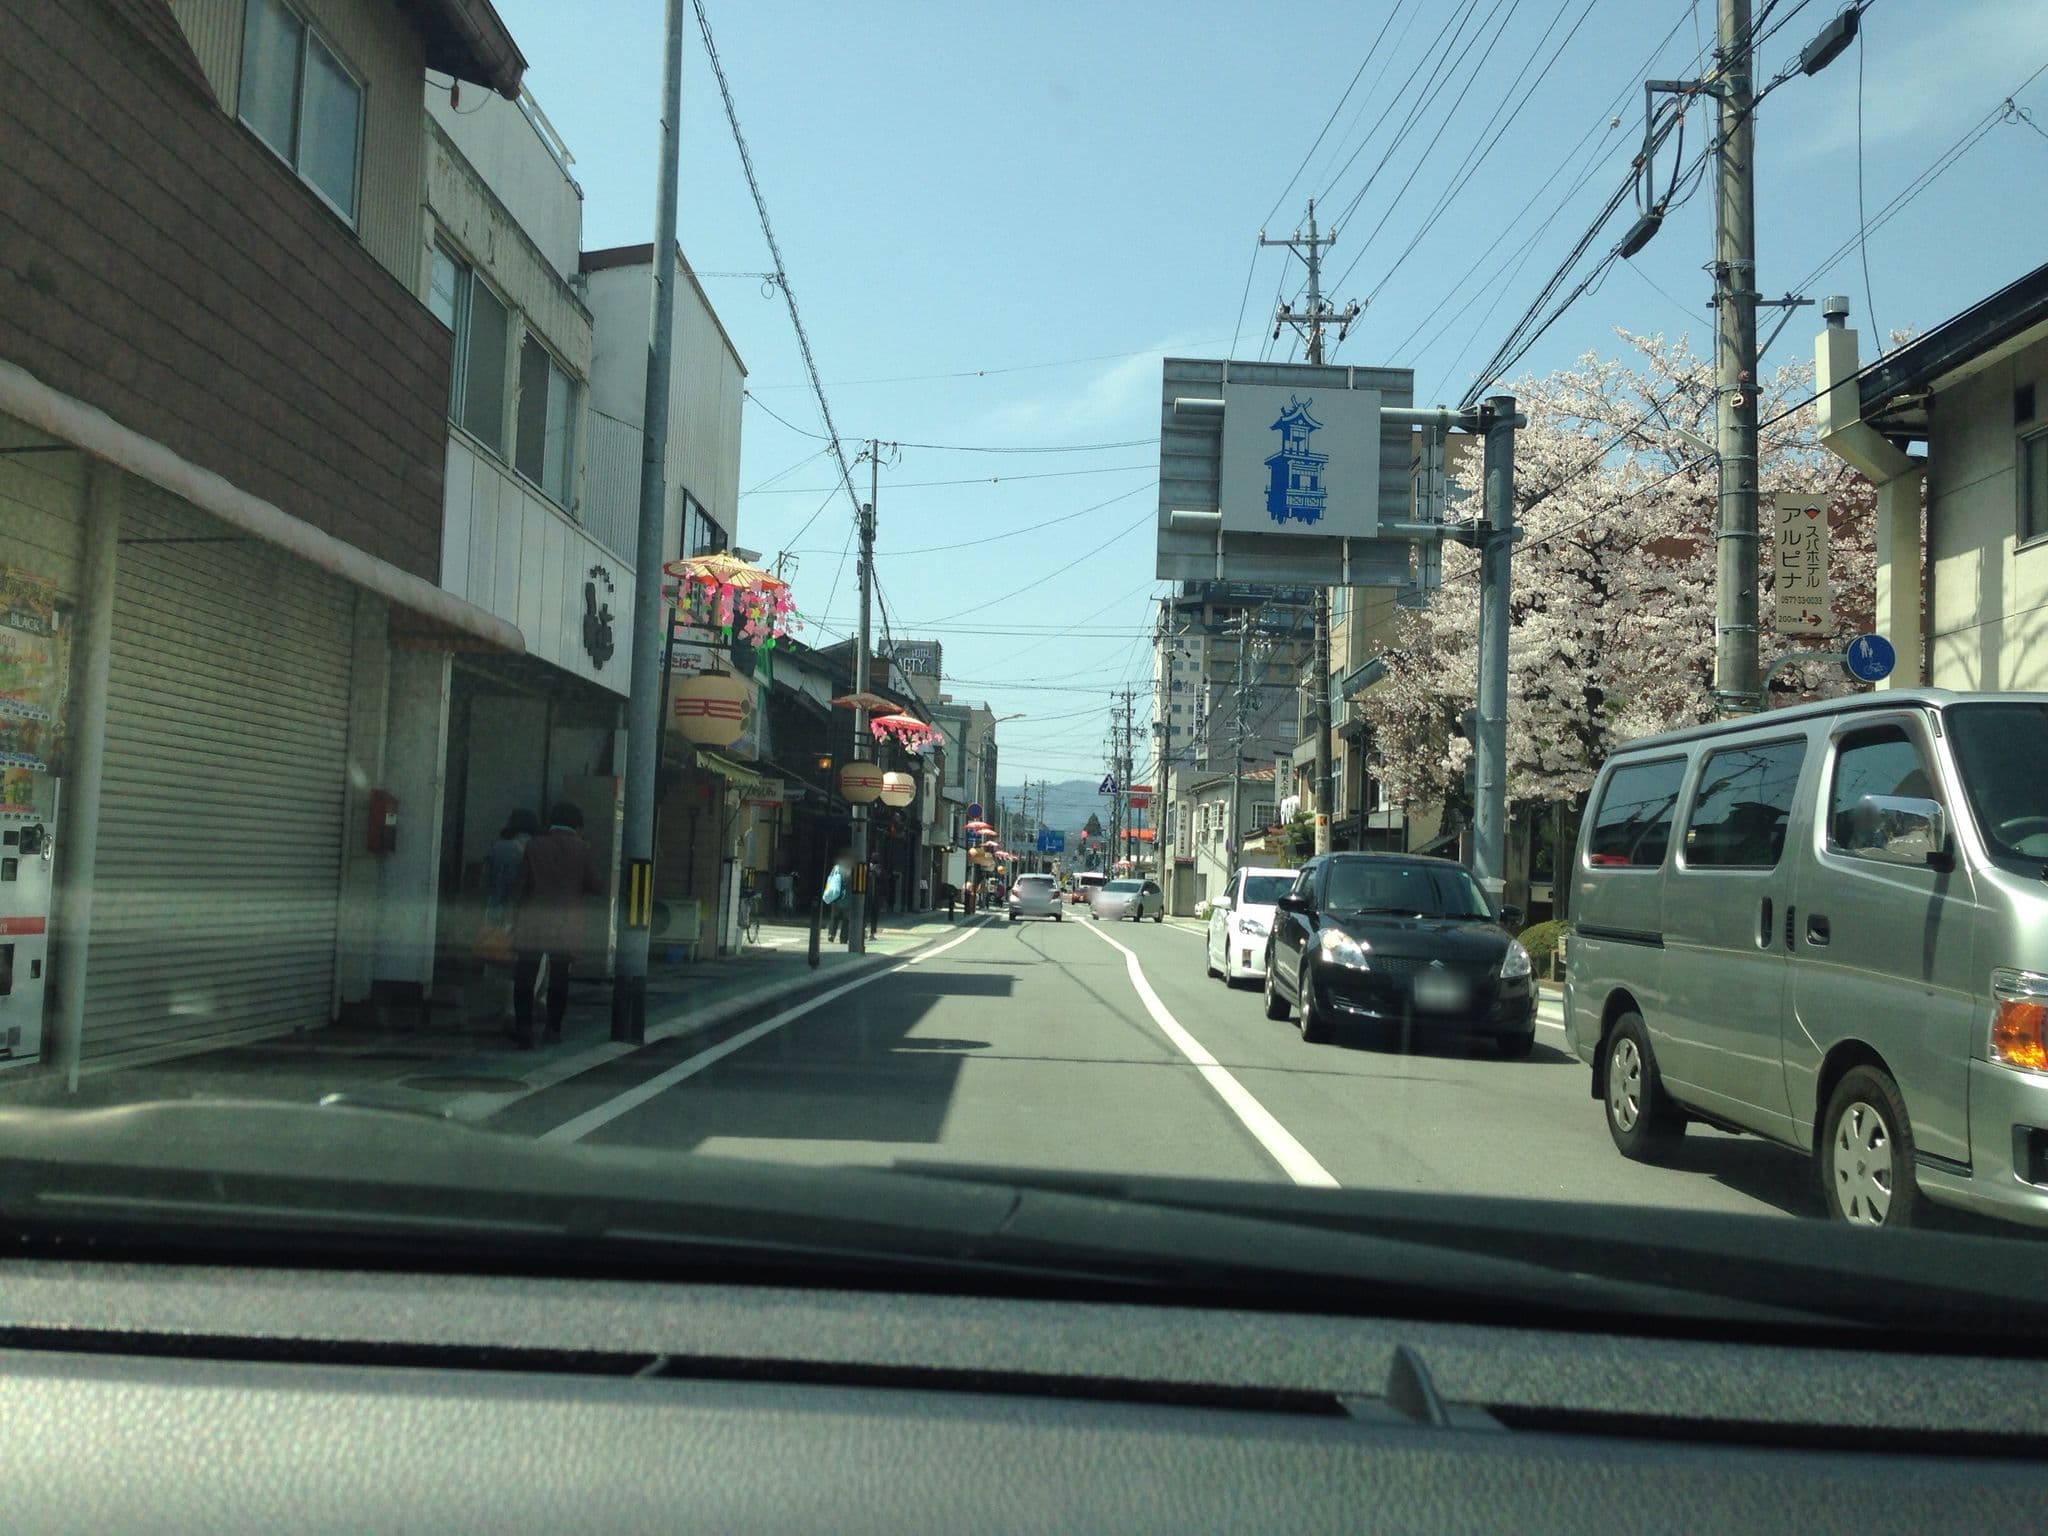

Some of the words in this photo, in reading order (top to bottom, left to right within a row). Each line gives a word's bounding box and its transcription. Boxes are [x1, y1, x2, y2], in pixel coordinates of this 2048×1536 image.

[1781, 507, 1802, 589] アルピナ
[1806, 526, 1820, 588] スパホテル
